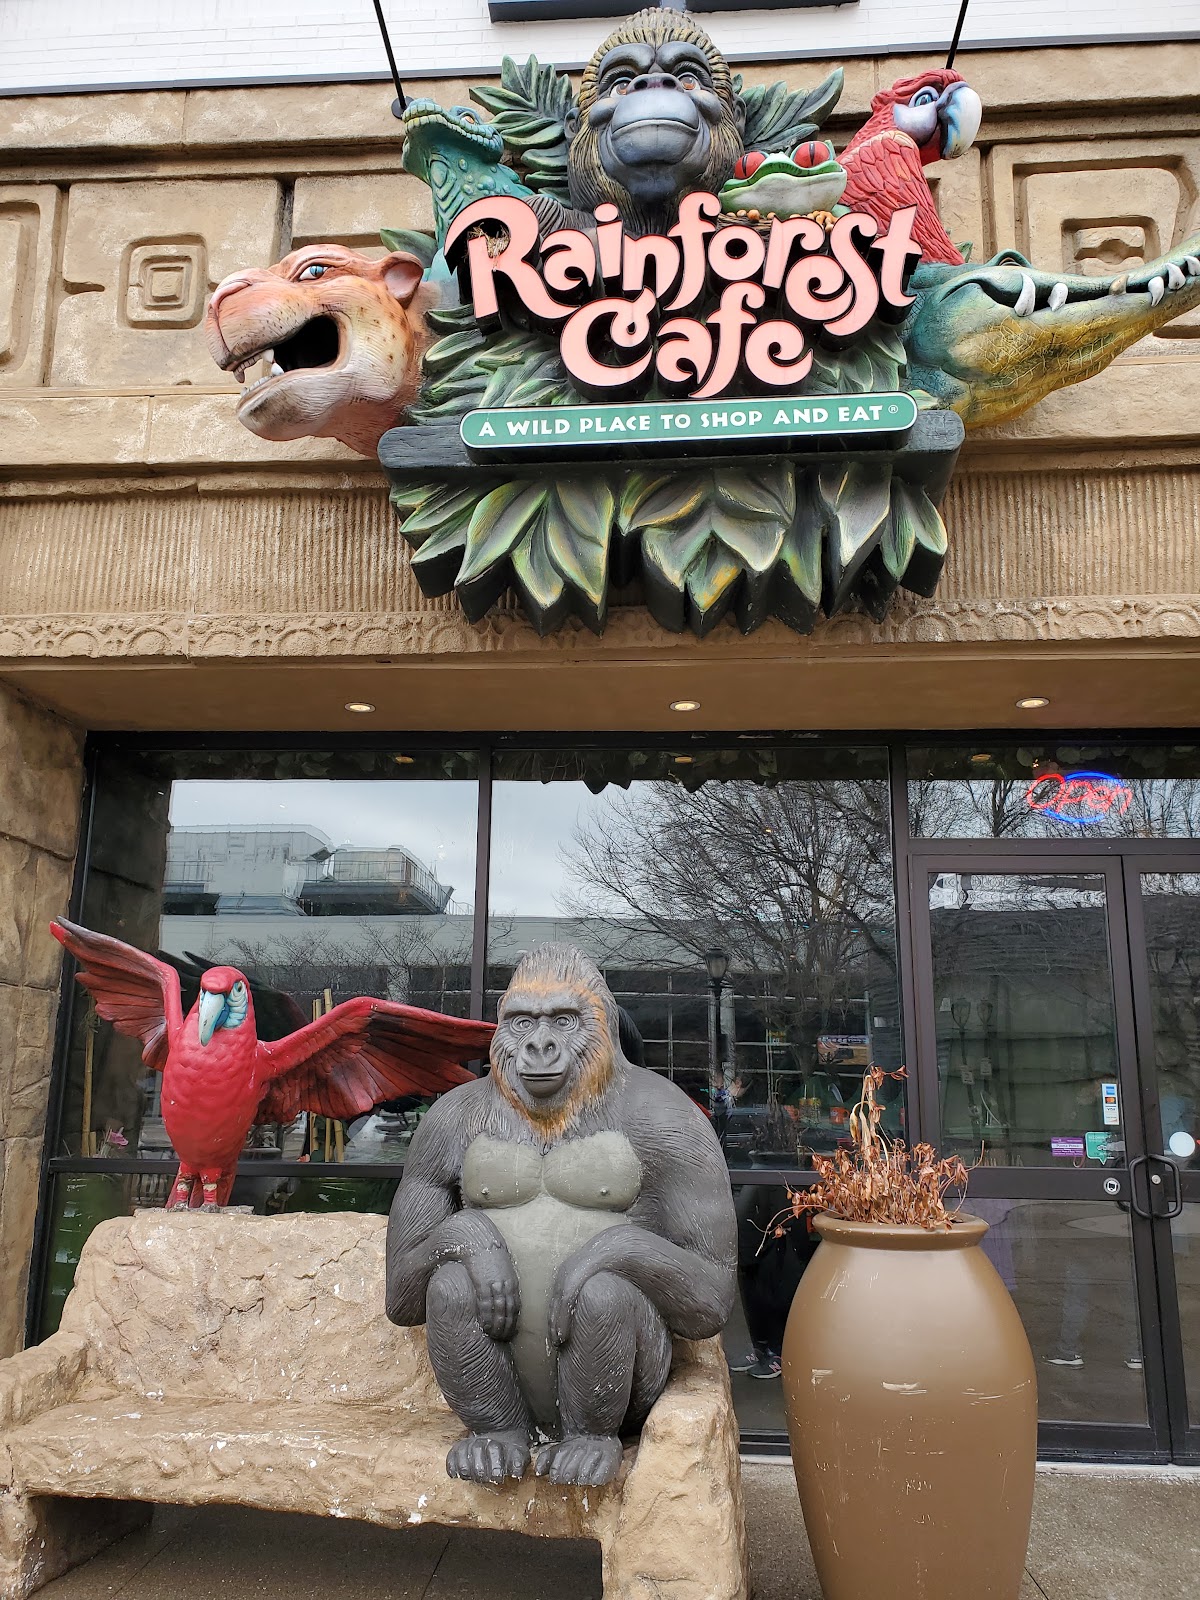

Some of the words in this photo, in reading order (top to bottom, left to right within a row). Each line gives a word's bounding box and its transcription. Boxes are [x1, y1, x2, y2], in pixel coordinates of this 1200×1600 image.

[444, 191, 922, 337] Rainforest
[559, 282, 813, 398] Cafe
[478, 421, 496, 437] A
[506, 418, 571, 436] WILD
[579, 415, 651, 433] PLACE
[660, 414, 691, 430] TO
[700, 410, 763, 428] SHOP
[773, 407, 829, 425] AND
[838, 405, 883, 422] EAT
